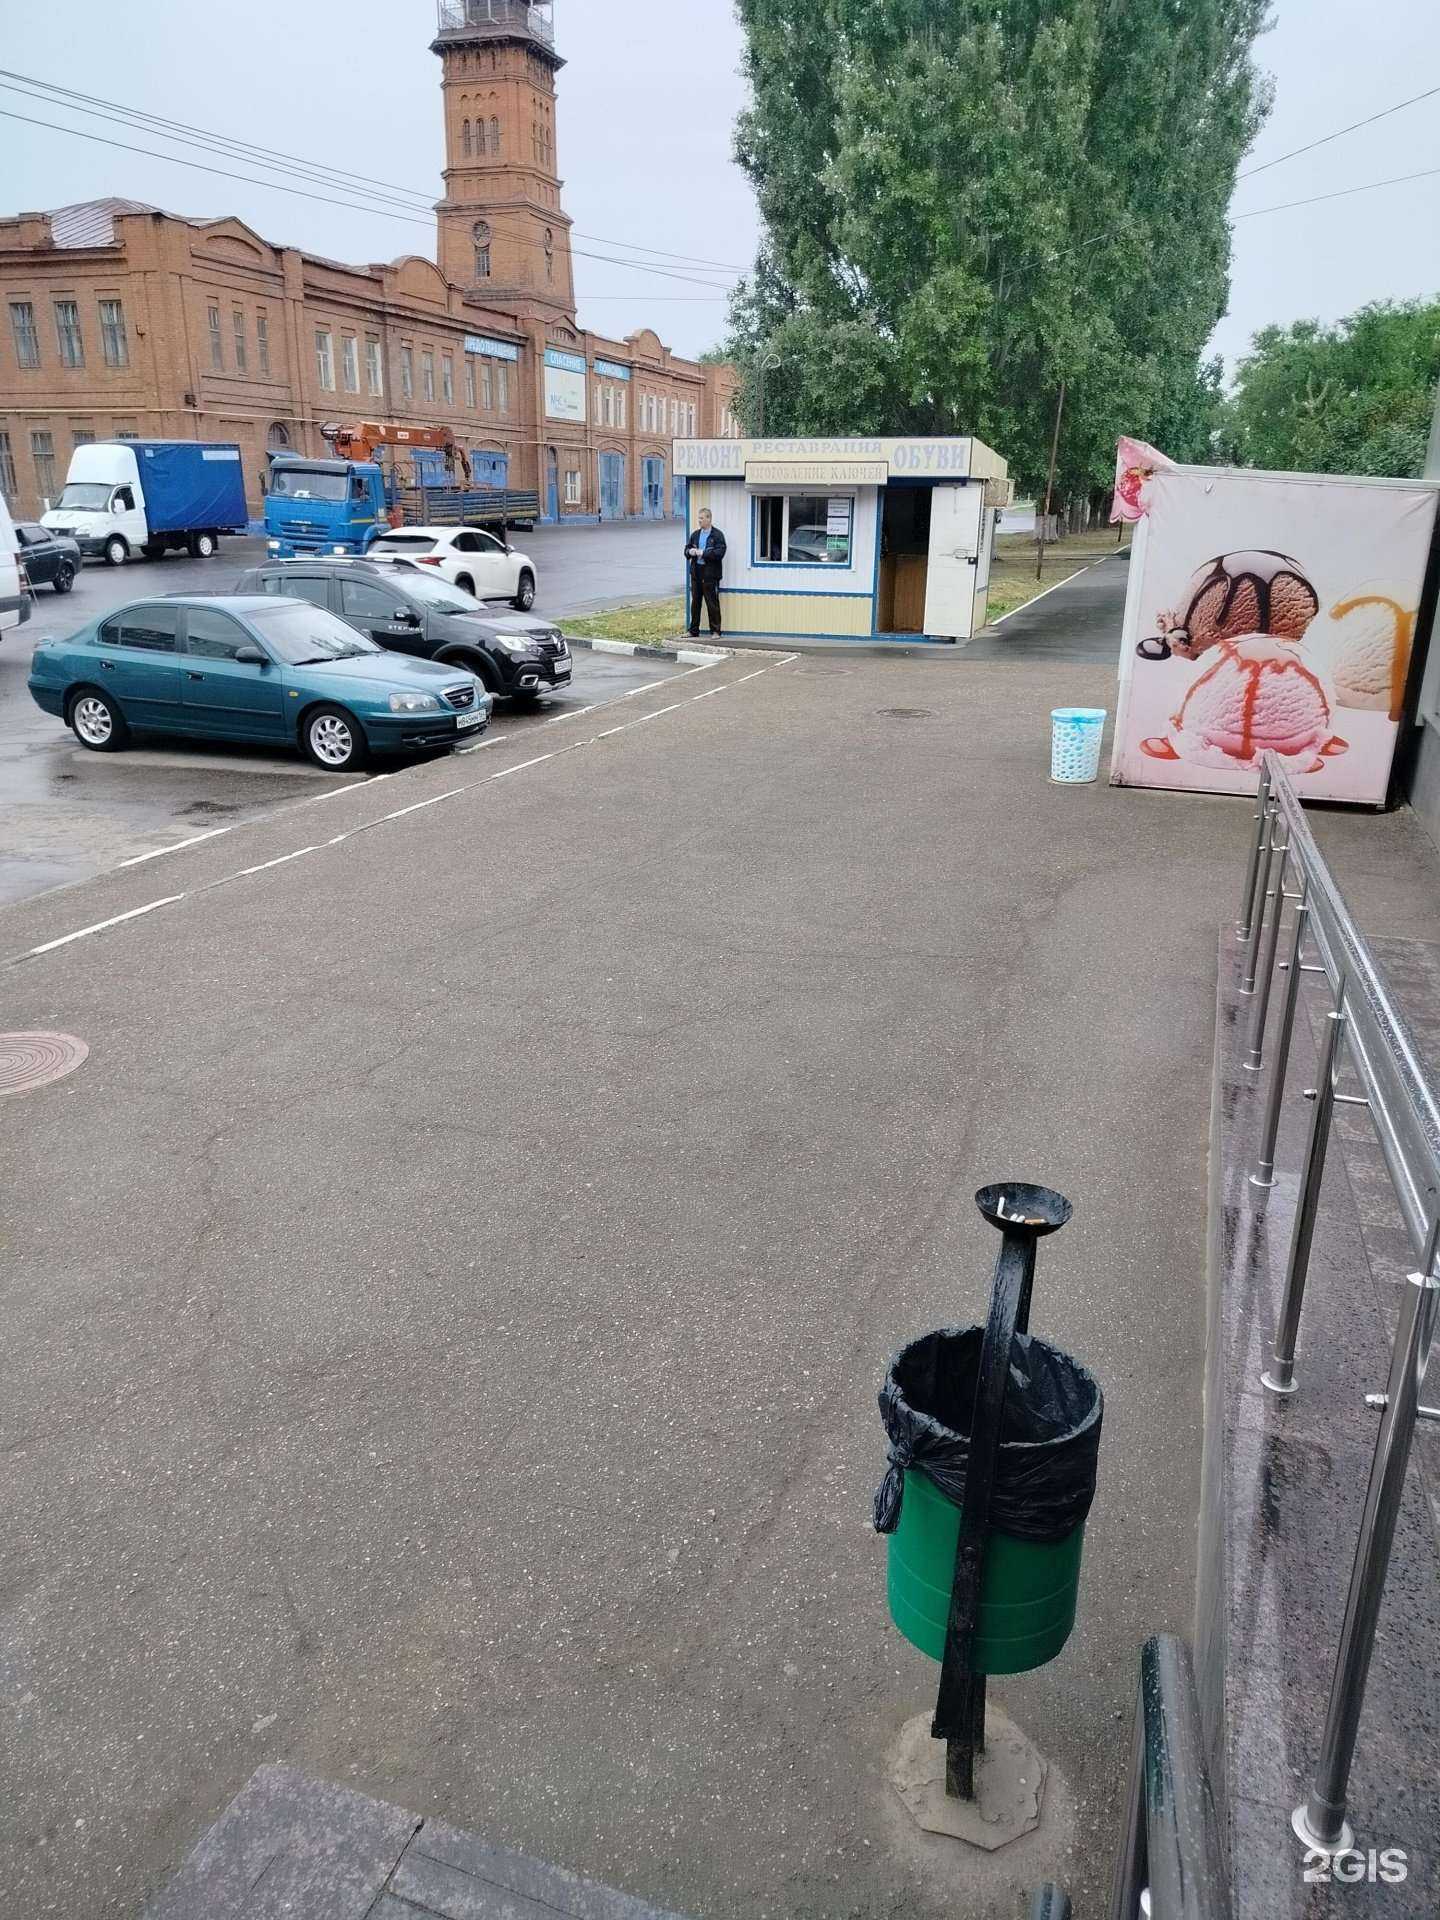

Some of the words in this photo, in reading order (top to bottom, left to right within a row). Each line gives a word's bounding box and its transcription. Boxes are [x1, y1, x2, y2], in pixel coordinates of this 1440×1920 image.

[751, 441, 881, 455] РЕСТАВРАЦИЯ
[676, 445, 742, 469] РЕМОНТ
[893, 444, 966, 470] ОБУВИ
[831, 465, 882, 481] КЛЮЧЕЙ
[388, 624, 425, 632] STEPWAY
